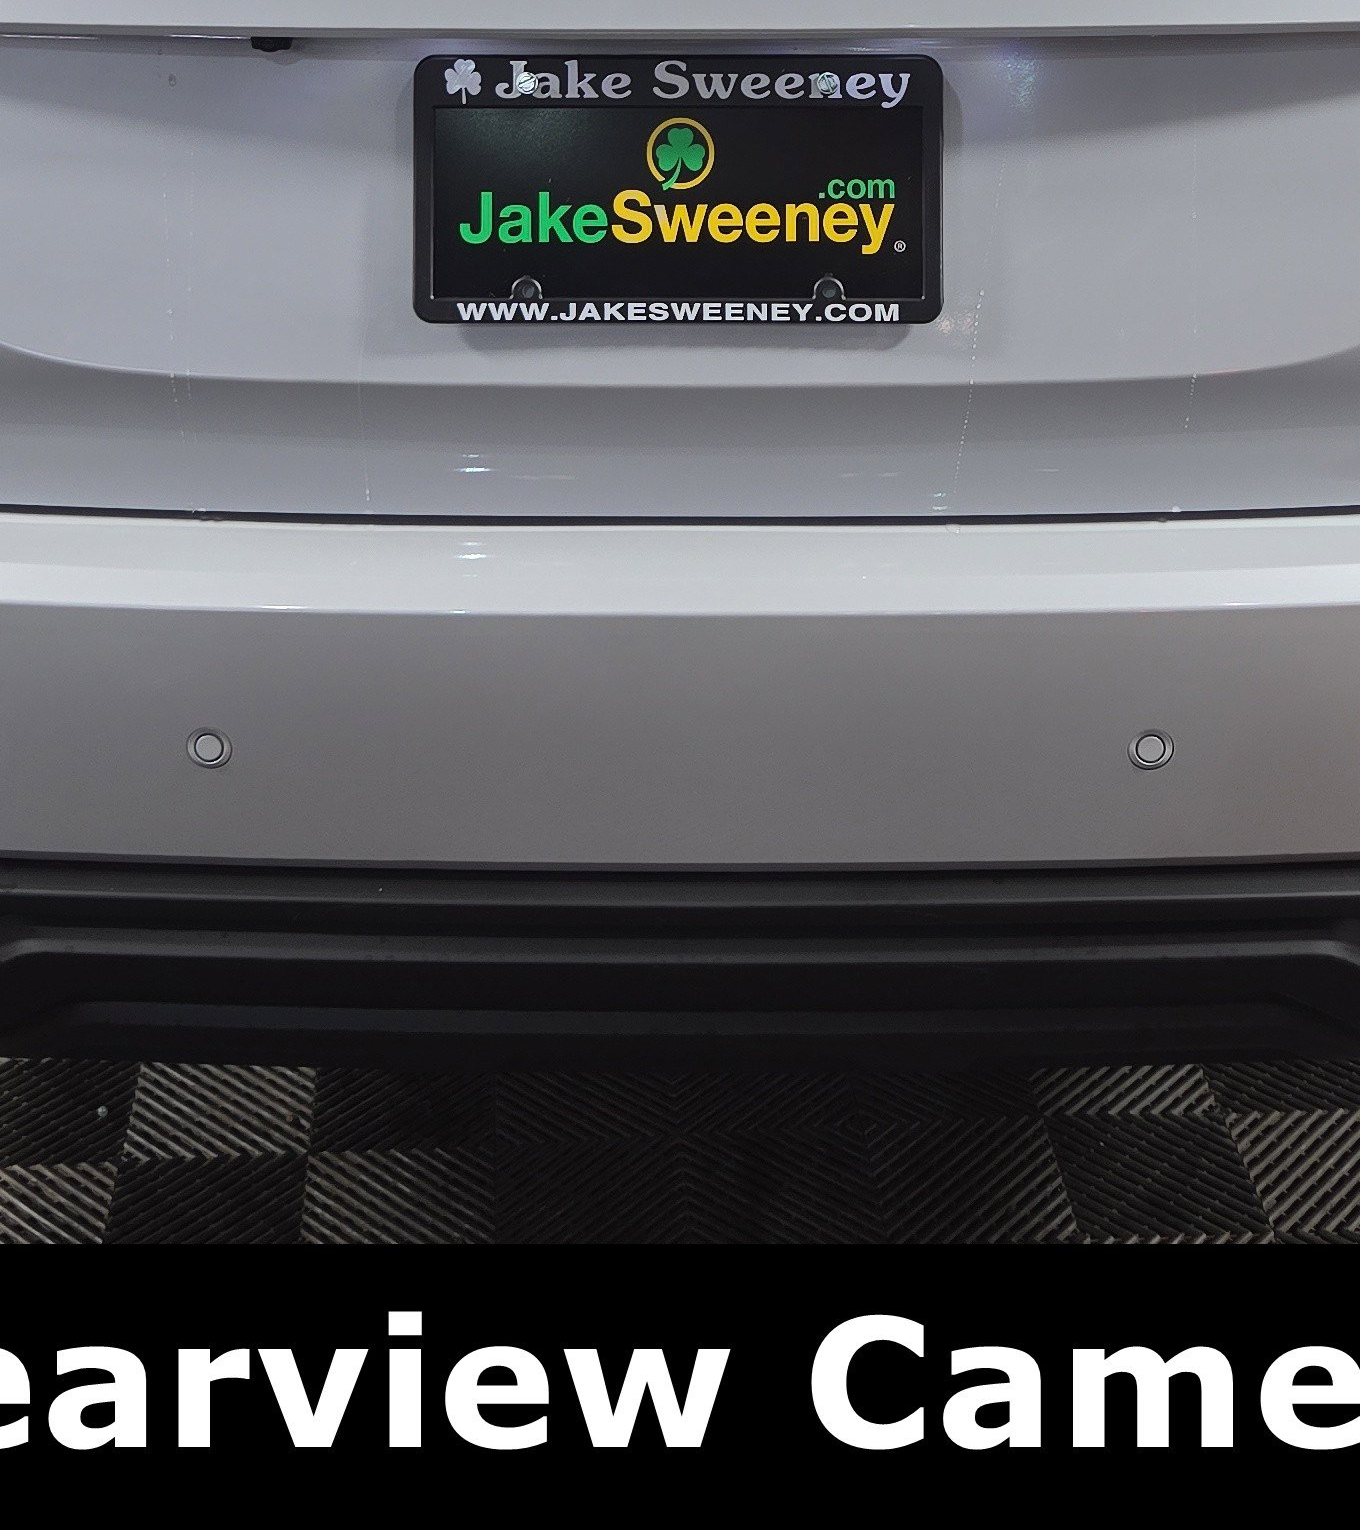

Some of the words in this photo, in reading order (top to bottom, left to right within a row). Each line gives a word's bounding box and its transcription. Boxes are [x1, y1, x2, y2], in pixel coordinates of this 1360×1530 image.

[495, 60, 632, 100] Jake
[652, 60, 911, 108] Sweeney
[818, 178, 895, 199] .com
[459, 189, 895, 254] JakeSweeney
[457, 302, 900, 322] WWW.JAKESWEENEY.COM
